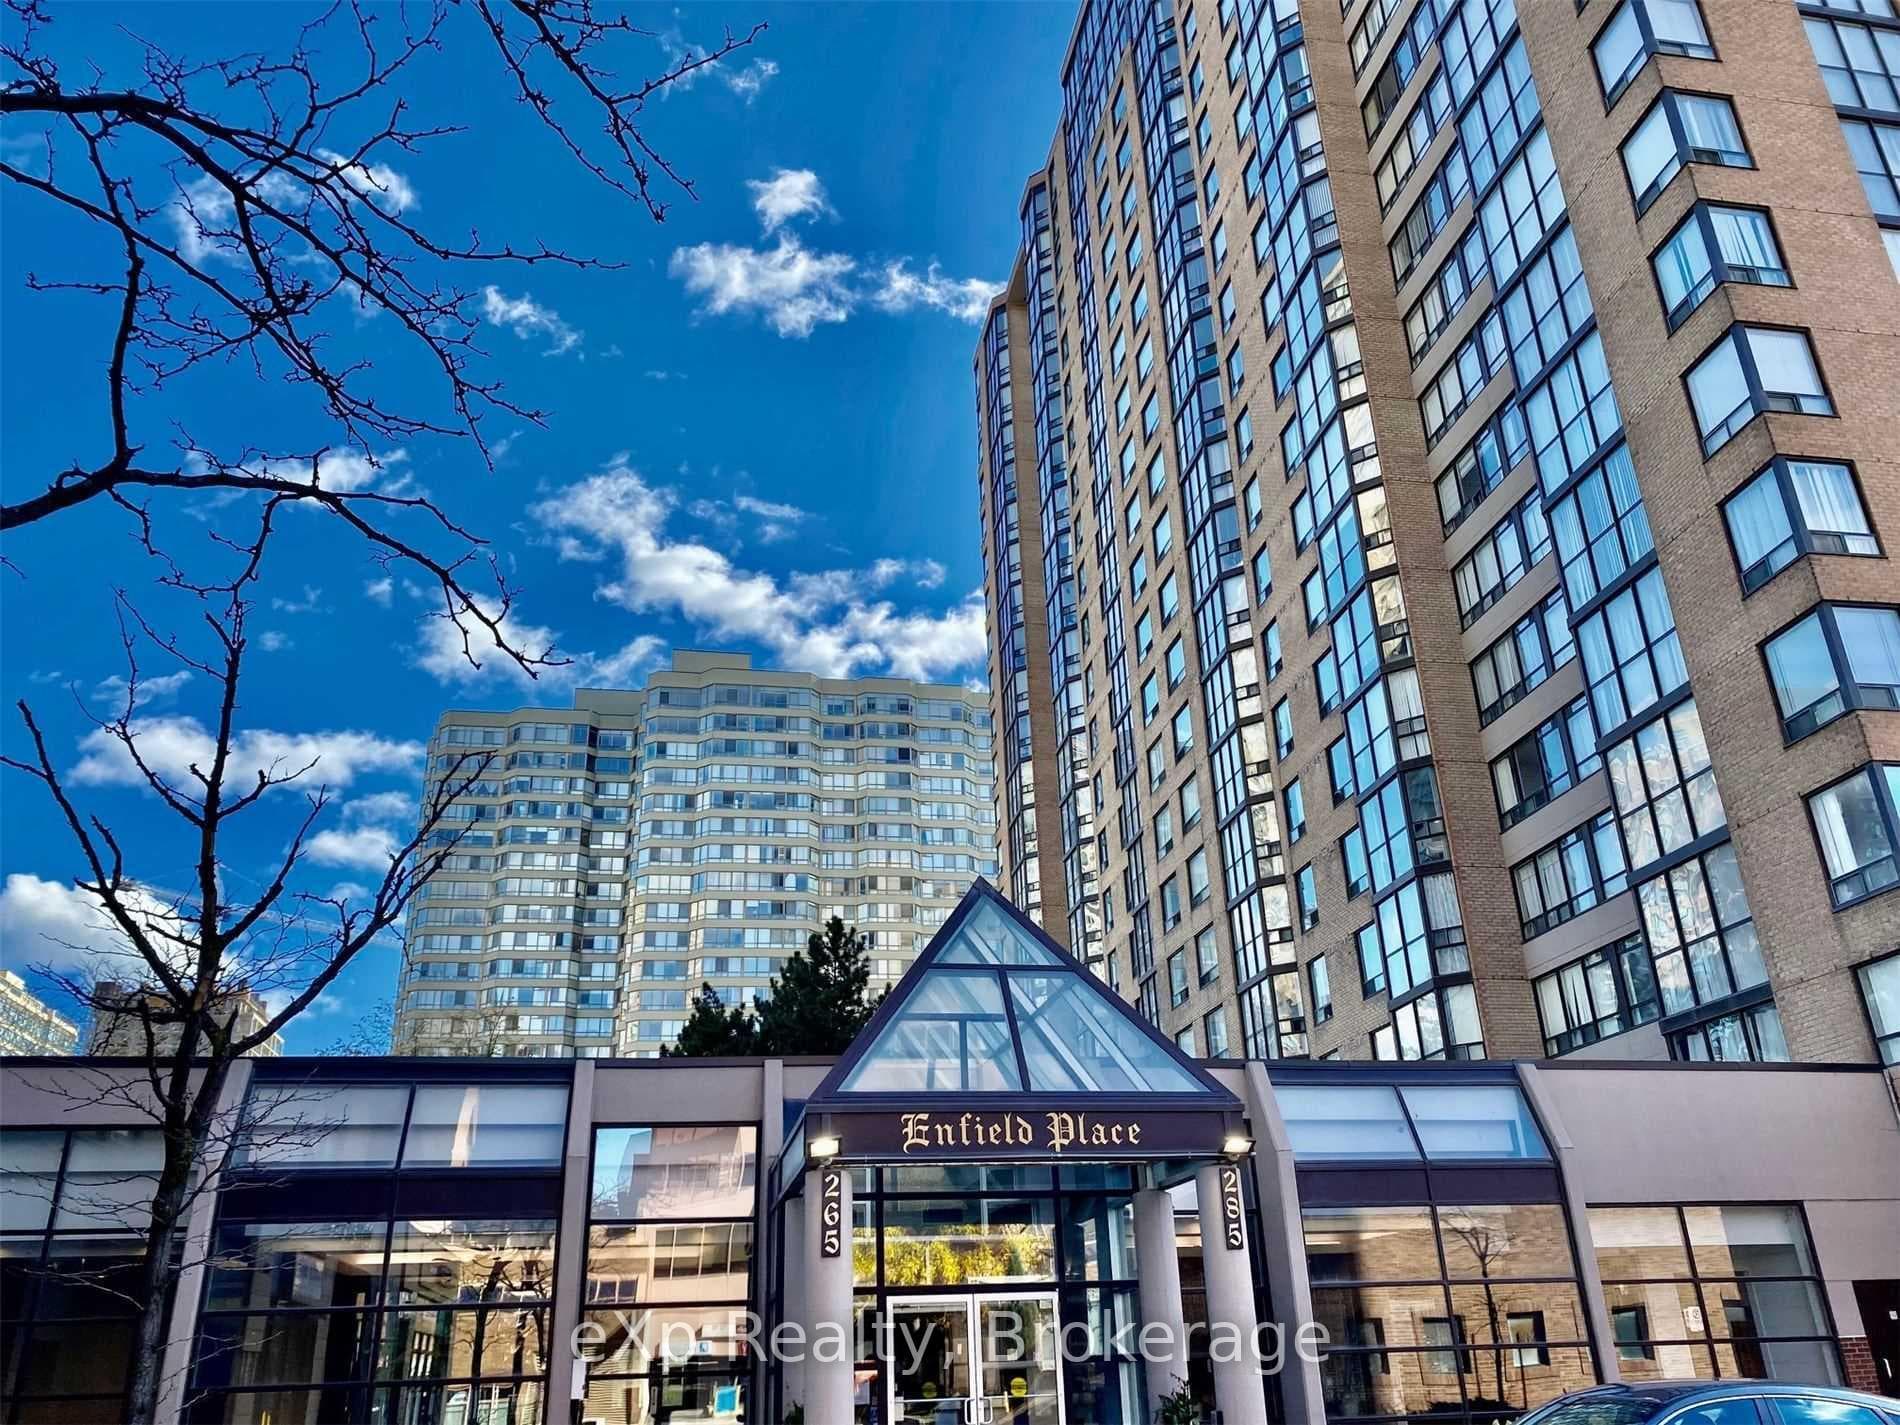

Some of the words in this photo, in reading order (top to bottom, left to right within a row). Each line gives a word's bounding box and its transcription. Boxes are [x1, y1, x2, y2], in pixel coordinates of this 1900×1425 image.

[901, 1112, 1033, 1153] Enfield
[1046, 1112, 1142, 1152] Place
[823, 1174, 840, 1255] 265
[1224, 1171, 1243, 1246] 285
